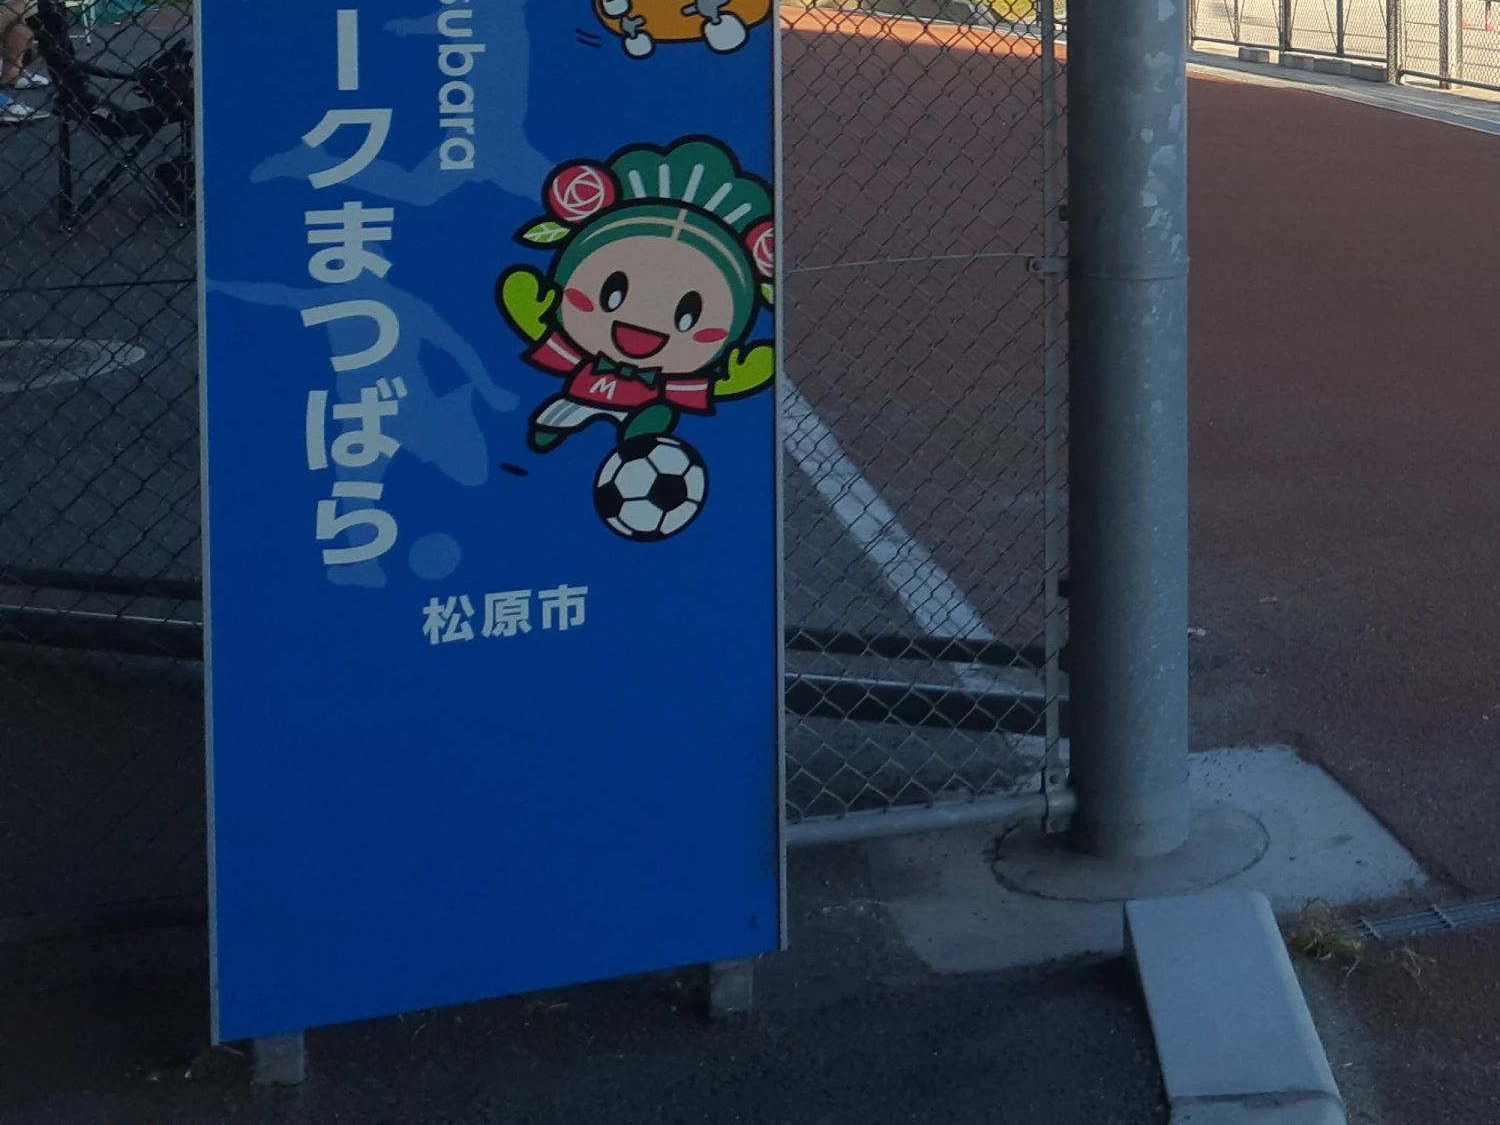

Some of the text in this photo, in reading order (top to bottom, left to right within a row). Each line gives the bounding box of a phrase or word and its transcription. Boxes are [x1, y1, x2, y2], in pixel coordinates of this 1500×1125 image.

[589, 376, 617, 401] M
[422, 583, 589, 646] 松原市
